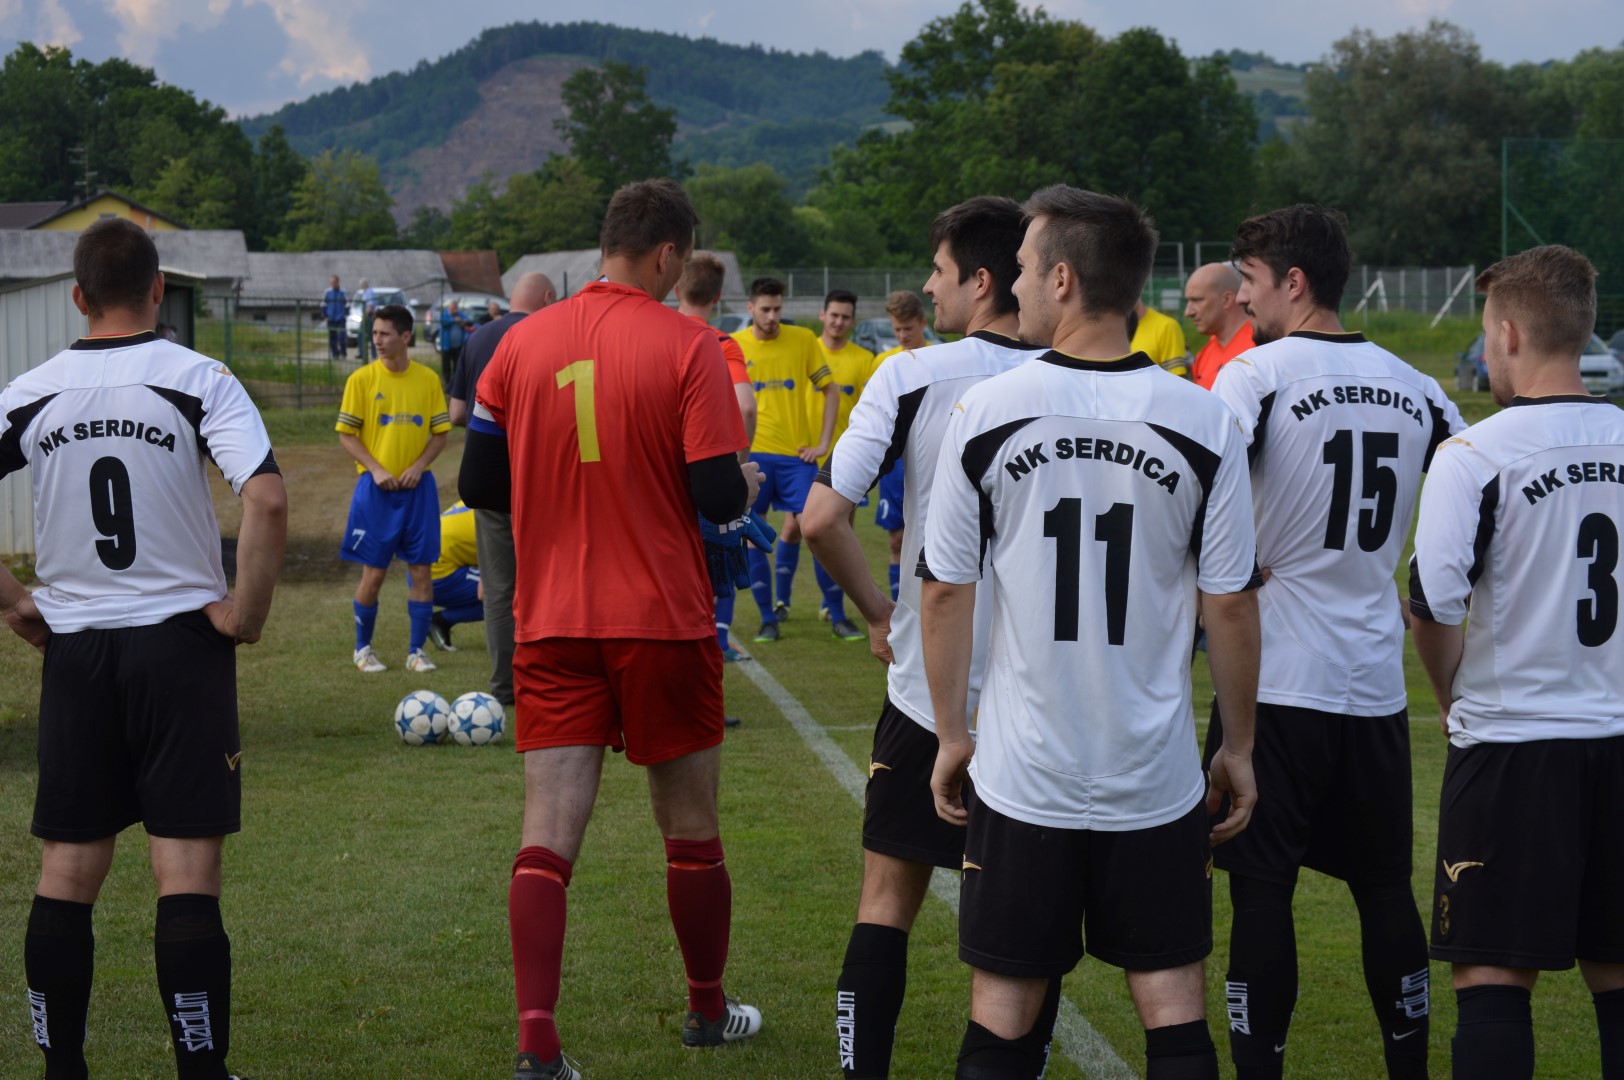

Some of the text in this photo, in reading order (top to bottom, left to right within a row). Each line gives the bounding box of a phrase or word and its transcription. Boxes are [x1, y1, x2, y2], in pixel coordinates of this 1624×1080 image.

[38, 419, 176, 457] NK SERDICA
[555, 359, 601, 462] 1
[1291, 385, 1423, 428] NK SERDICA
[1004, 437, 1181, 496] NK SERDICA
[1323, 429, 1399, 553] 15
[1521, 467, 1565, 506] NK
[89, 456, 137, 571] 9
[351, 528, 366, 551] 7
[1043, 497, 1135, 646] 11
[1576, 512, 1619, 648] 3
